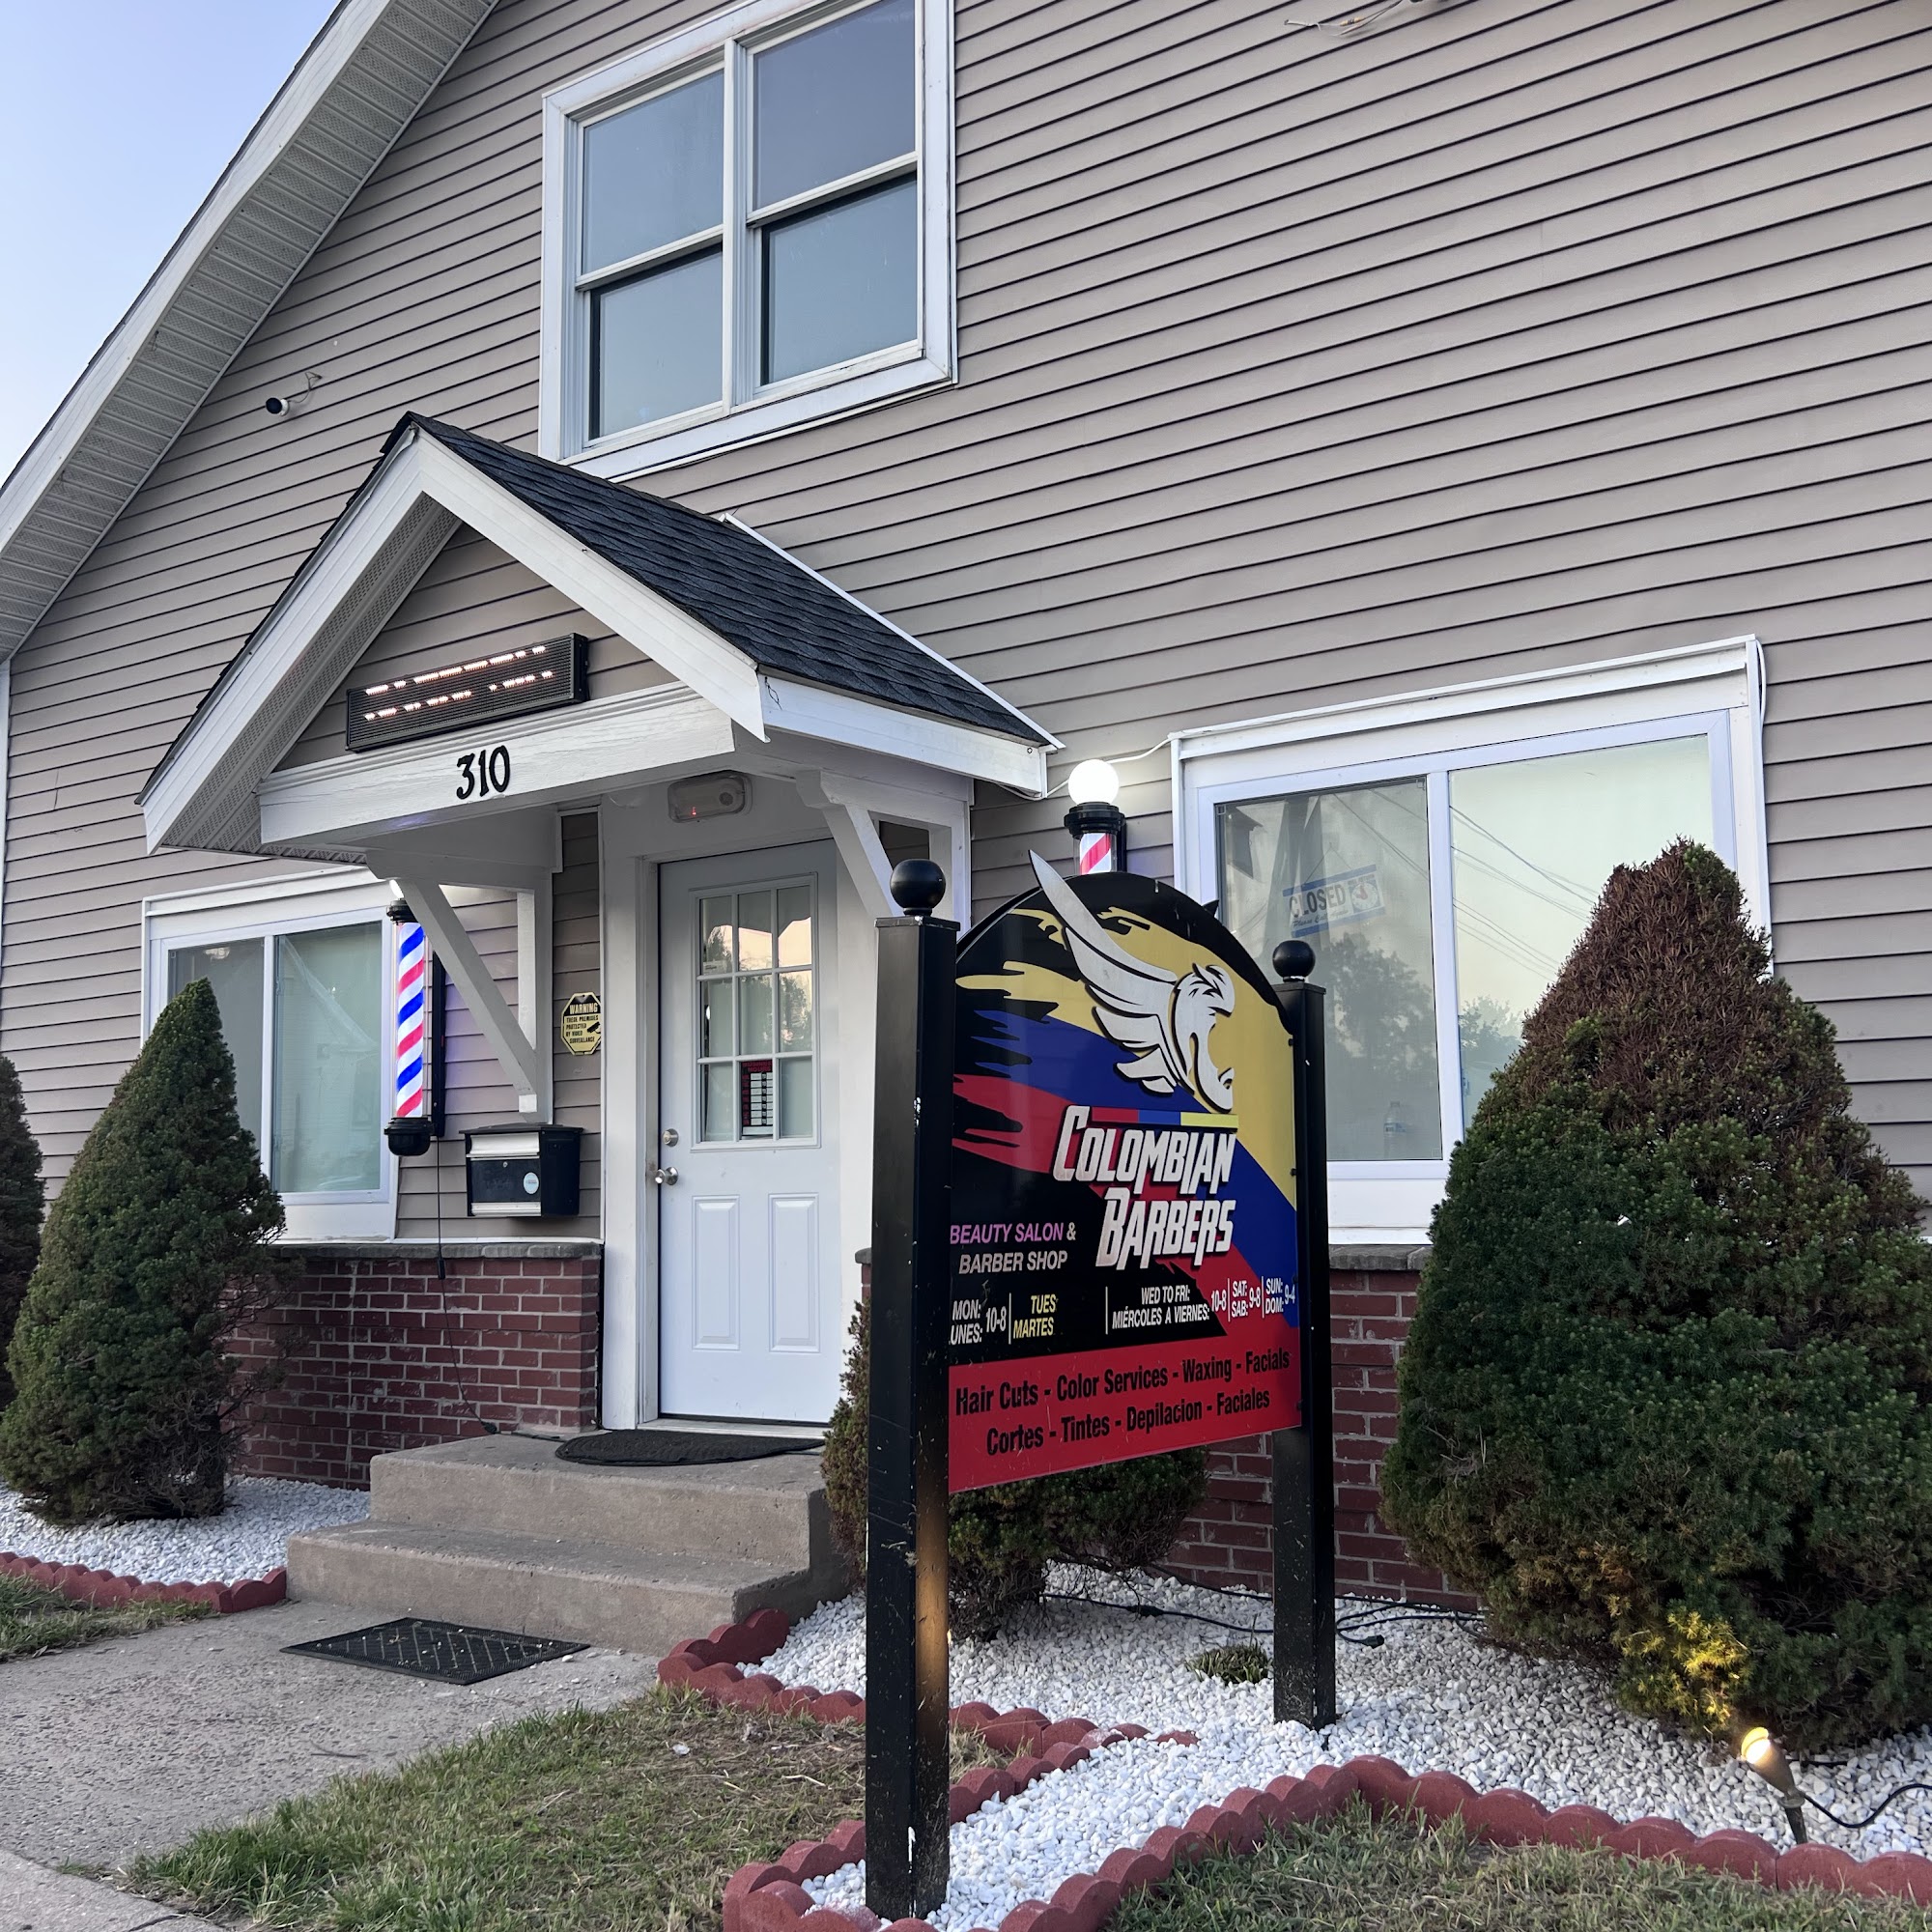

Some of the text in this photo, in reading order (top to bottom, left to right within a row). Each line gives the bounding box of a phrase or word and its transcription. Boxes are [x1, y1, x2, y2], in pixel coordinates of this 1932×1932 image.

[456, 745, 511, 800] 310
[1289, 884, 1347, 918] CLOSED
[570, 1003, 598, 1014] WARNING
[1052, 1105, 1236, 1194] COLOMBIAN
[950, 1222, 1076, 1244] BEAUTY SALON &
[1095, 1187, 1236, 1270] BARBERS
[958, 1250, 1067, 1274] BARBER SHOP
[1141, 1284, 1190, 1305] WED TO FRI:
[1232, 1280, 1247, 1297] SAT:
[1265, 1277, 1283, 1294] SUN:
[1284, 1284, 1295, 1305] 9-4
[1211, 1289, 1227, 1312] 10-8
[1249, 1287, 1261, 1308] 9-8
[1264, 1296, 1284, 1314] DOM:
[952, 1299, 981, 1321] MON:
[985, 1306, 1007, 1333] 10-8
[1112, 1303, 1209, 1329] MIÉRCOLES A VIERNES:
[1231, 1300, 1248, 1318] SAB:
[949, 1322, 983, 1345] UNES:
[1012, 1317, 1055, 1339] MARTES
[955, 1385, 994, 1416] Hair
[999, 1380, 1038, 1409] Cuts
[1057, 1373, 1099, 1401] Color
[1104, 1365, 1168, 1394] Services
[1182, 1356, 1232, 1382] Waxing
[1245, 1348, 1290, 1374] Facials
[986, 1424, 1044, 1456] Cortes
[1061, 1414, 1110, 1442] Tintes
[1126, 1399, 1203, 1434] Depilacion
[1216, 1387, 1270, 1416] Faciales
